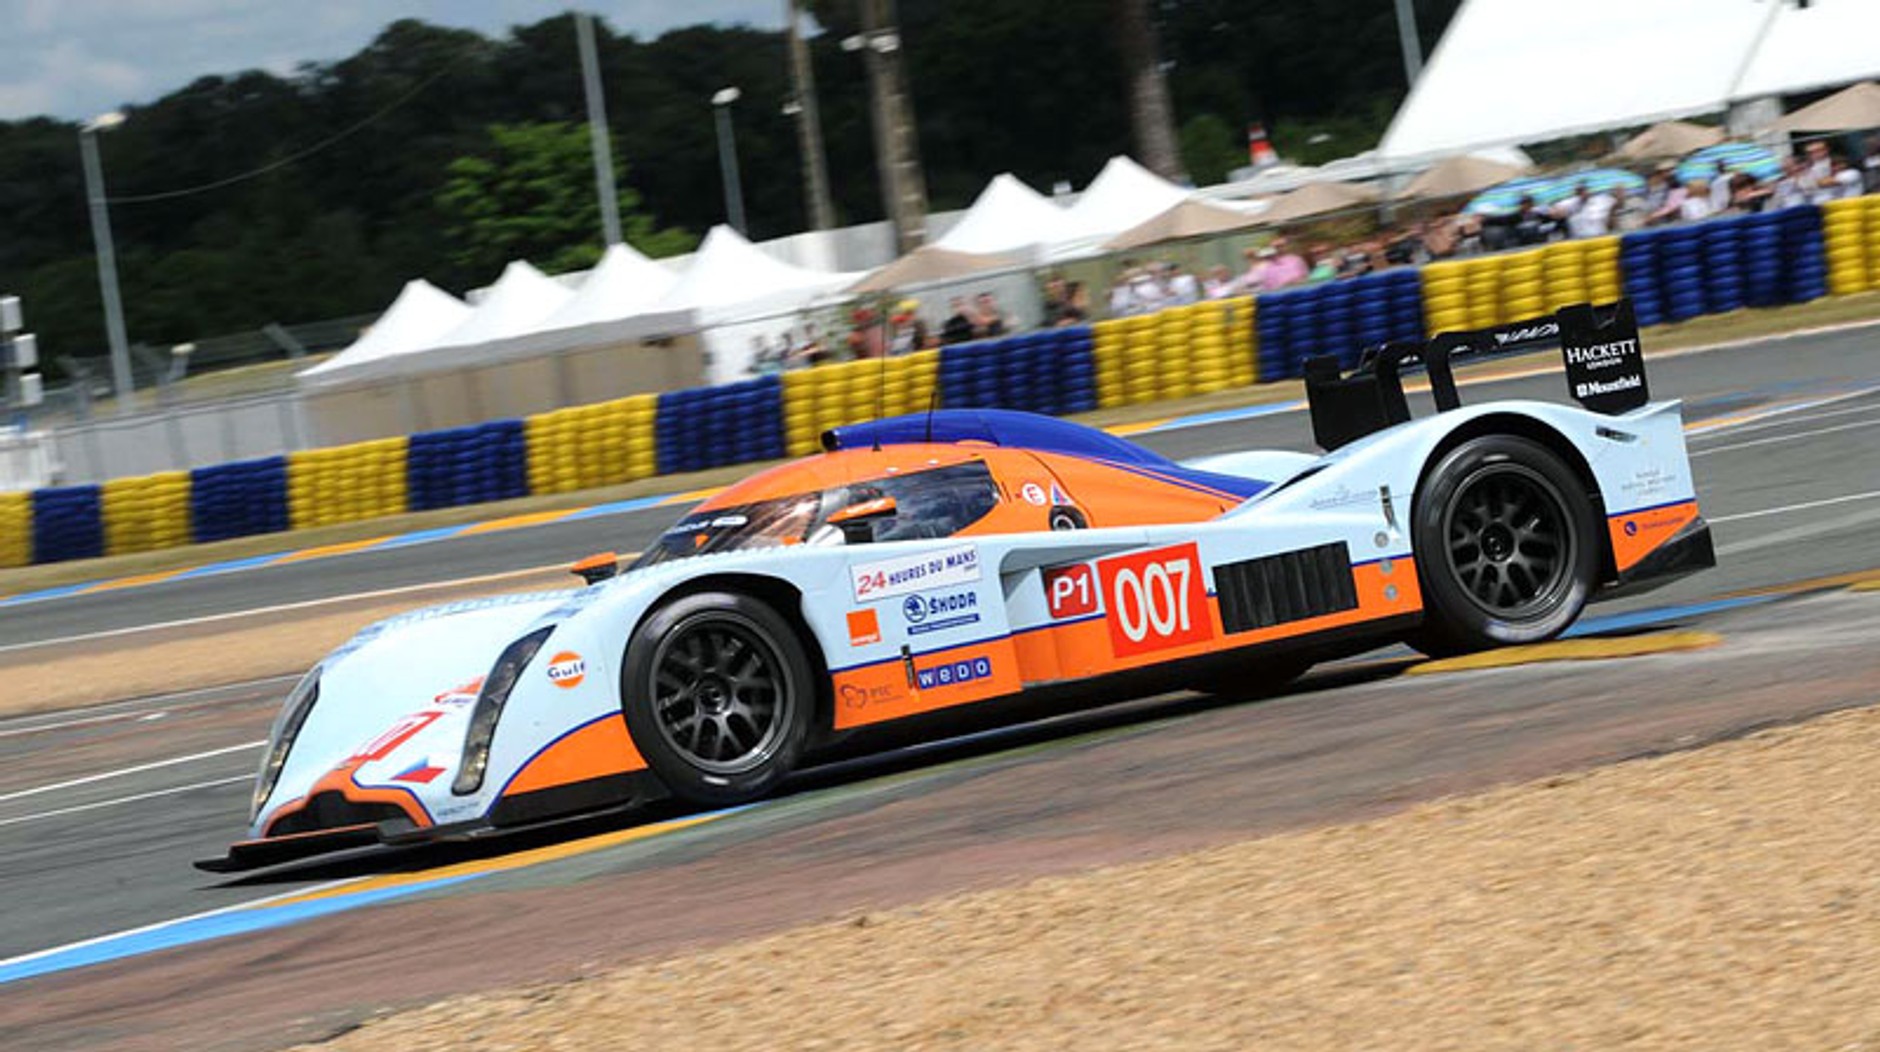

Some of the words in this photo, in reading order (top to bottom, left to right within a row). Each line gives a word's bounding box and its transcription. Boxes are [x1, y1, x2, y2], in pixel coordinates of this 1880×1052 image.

[1566, 338, 1636, 364] HACKETT
[858, 570, 886, 595] 24
[889, 564, 927, 586] HEURES
[929, 559, 943, 574] DU
[946, 549, 976, 568] MANS
[1053, 572, 1089, 611] P1
[1114, 558, 1191, 643] 007
[547, 661, 585, 680] Gulf
